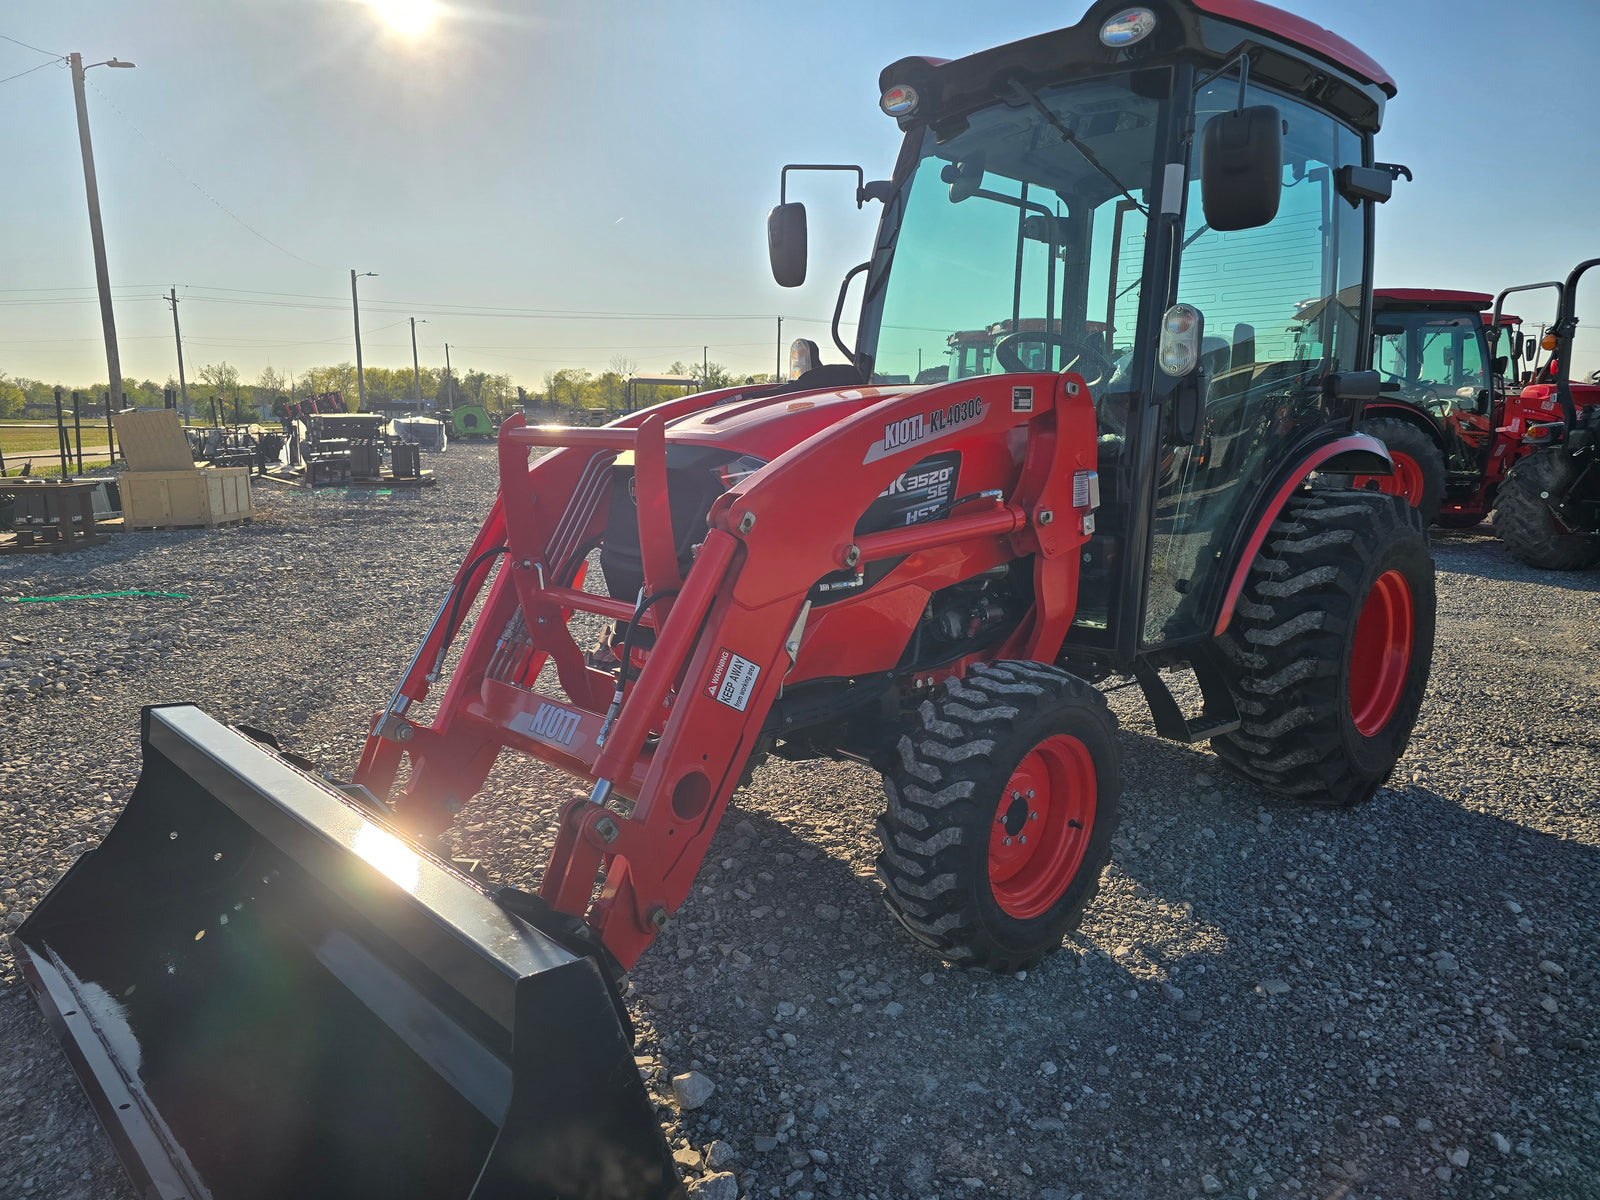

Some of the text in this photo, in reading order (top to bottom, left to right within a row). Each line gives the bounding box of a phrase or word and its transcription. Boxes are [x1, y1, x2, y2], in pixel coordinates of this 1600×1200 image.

[884, 412, 924, 451] KIOTI
[930, 396, 982, 432] KL4030C
[927, 482, 949, 499] SE
[711, 651, 729, 684] WARNING
[721, 658, 745, 703] KEEP AWAY
[740, 676, 752, 696] working
[747, 665, 756, 677] area
[529, 702, 582, 745] KIOTI
